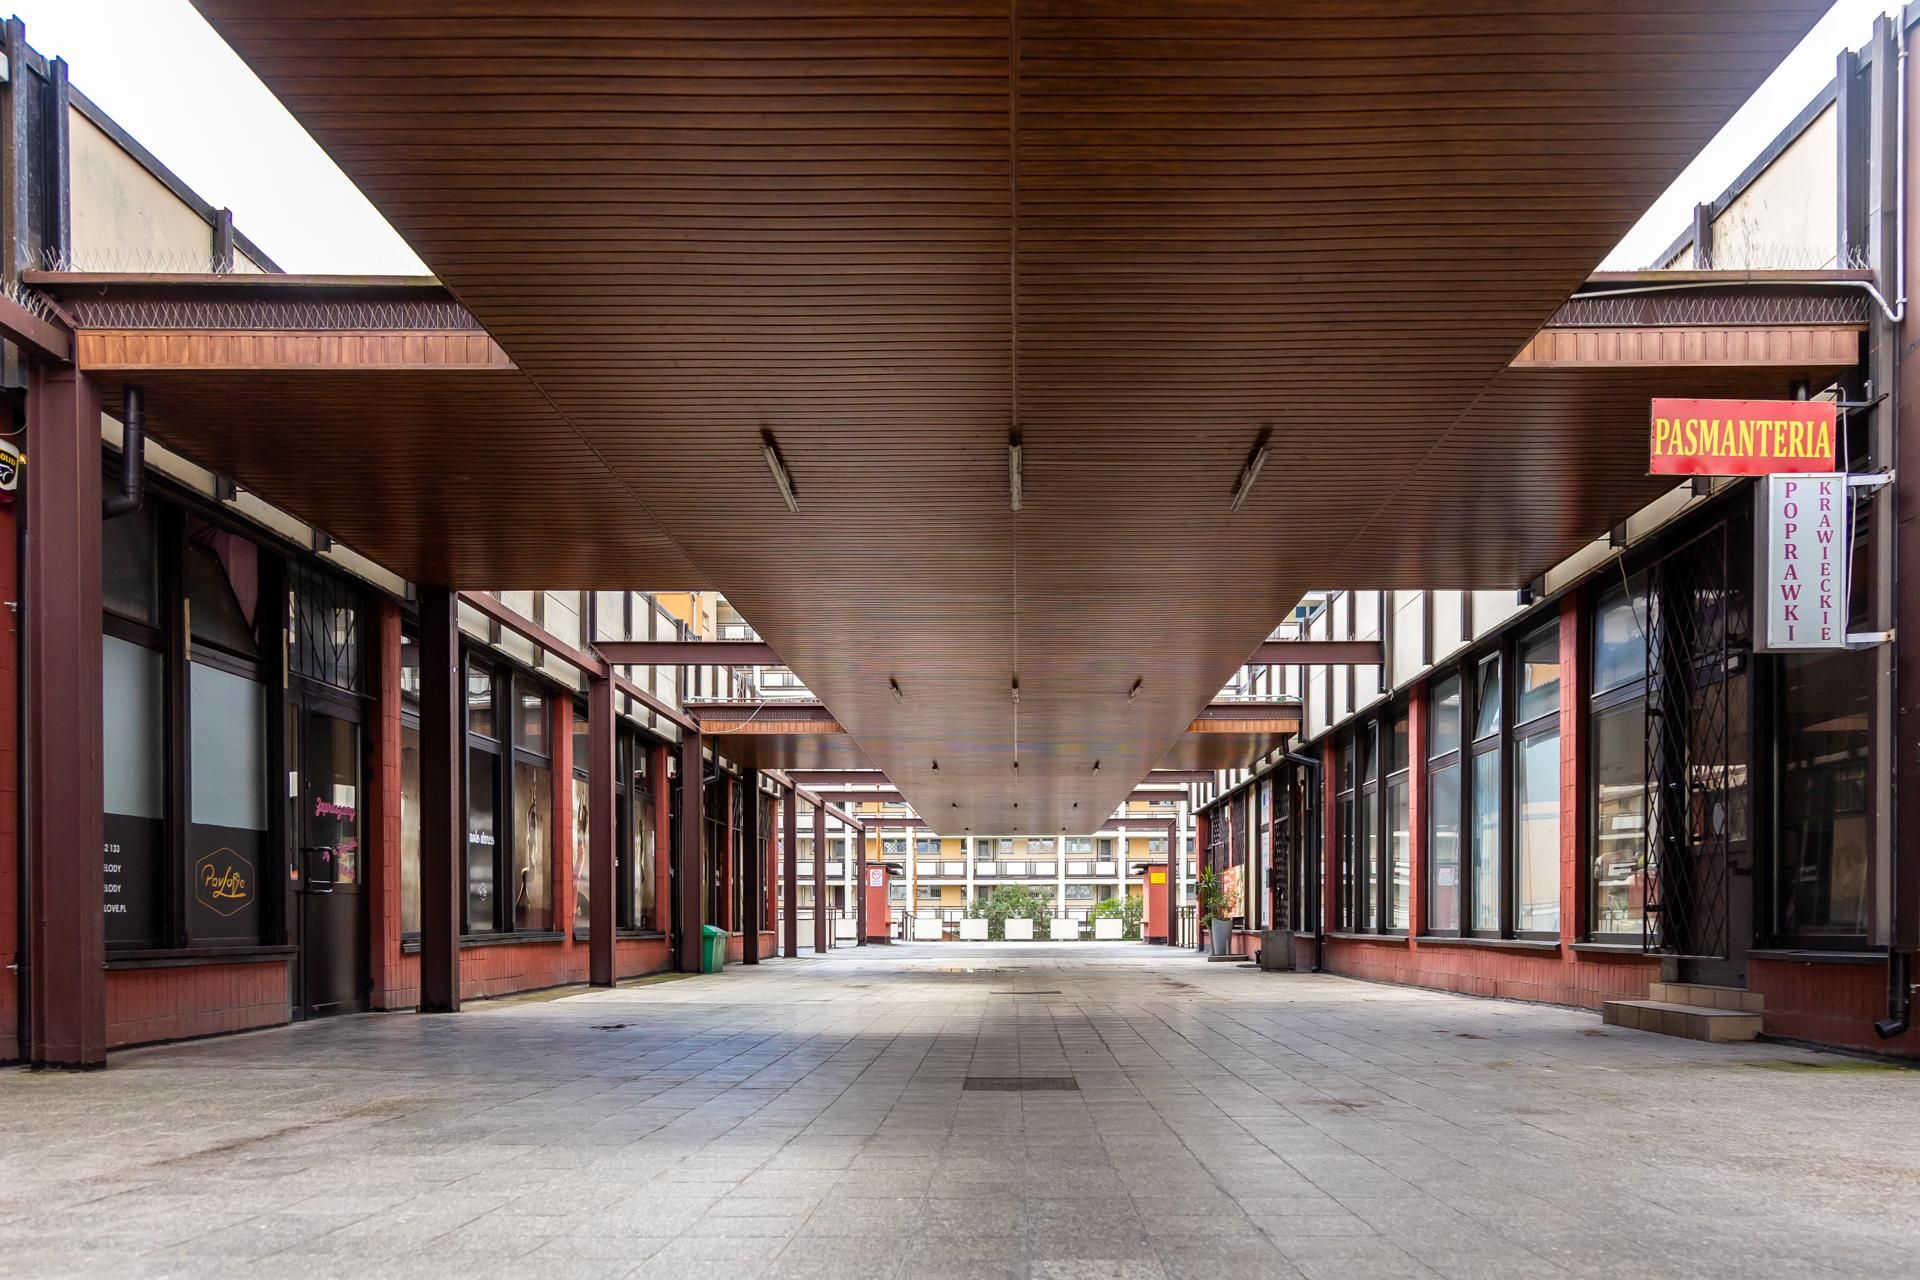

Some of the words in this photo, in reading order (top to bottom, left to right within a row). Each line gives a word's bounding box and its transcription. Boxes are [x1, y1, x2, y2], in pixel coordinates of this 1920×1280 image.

[0, 453, 16, 466] OLID
[1654, 418, 1832, 458] PASMANTERIA
[1781, 482, 1802, 641] POPRAWKI
[1816, 481, 1834, 641] KRAWIECKIE
